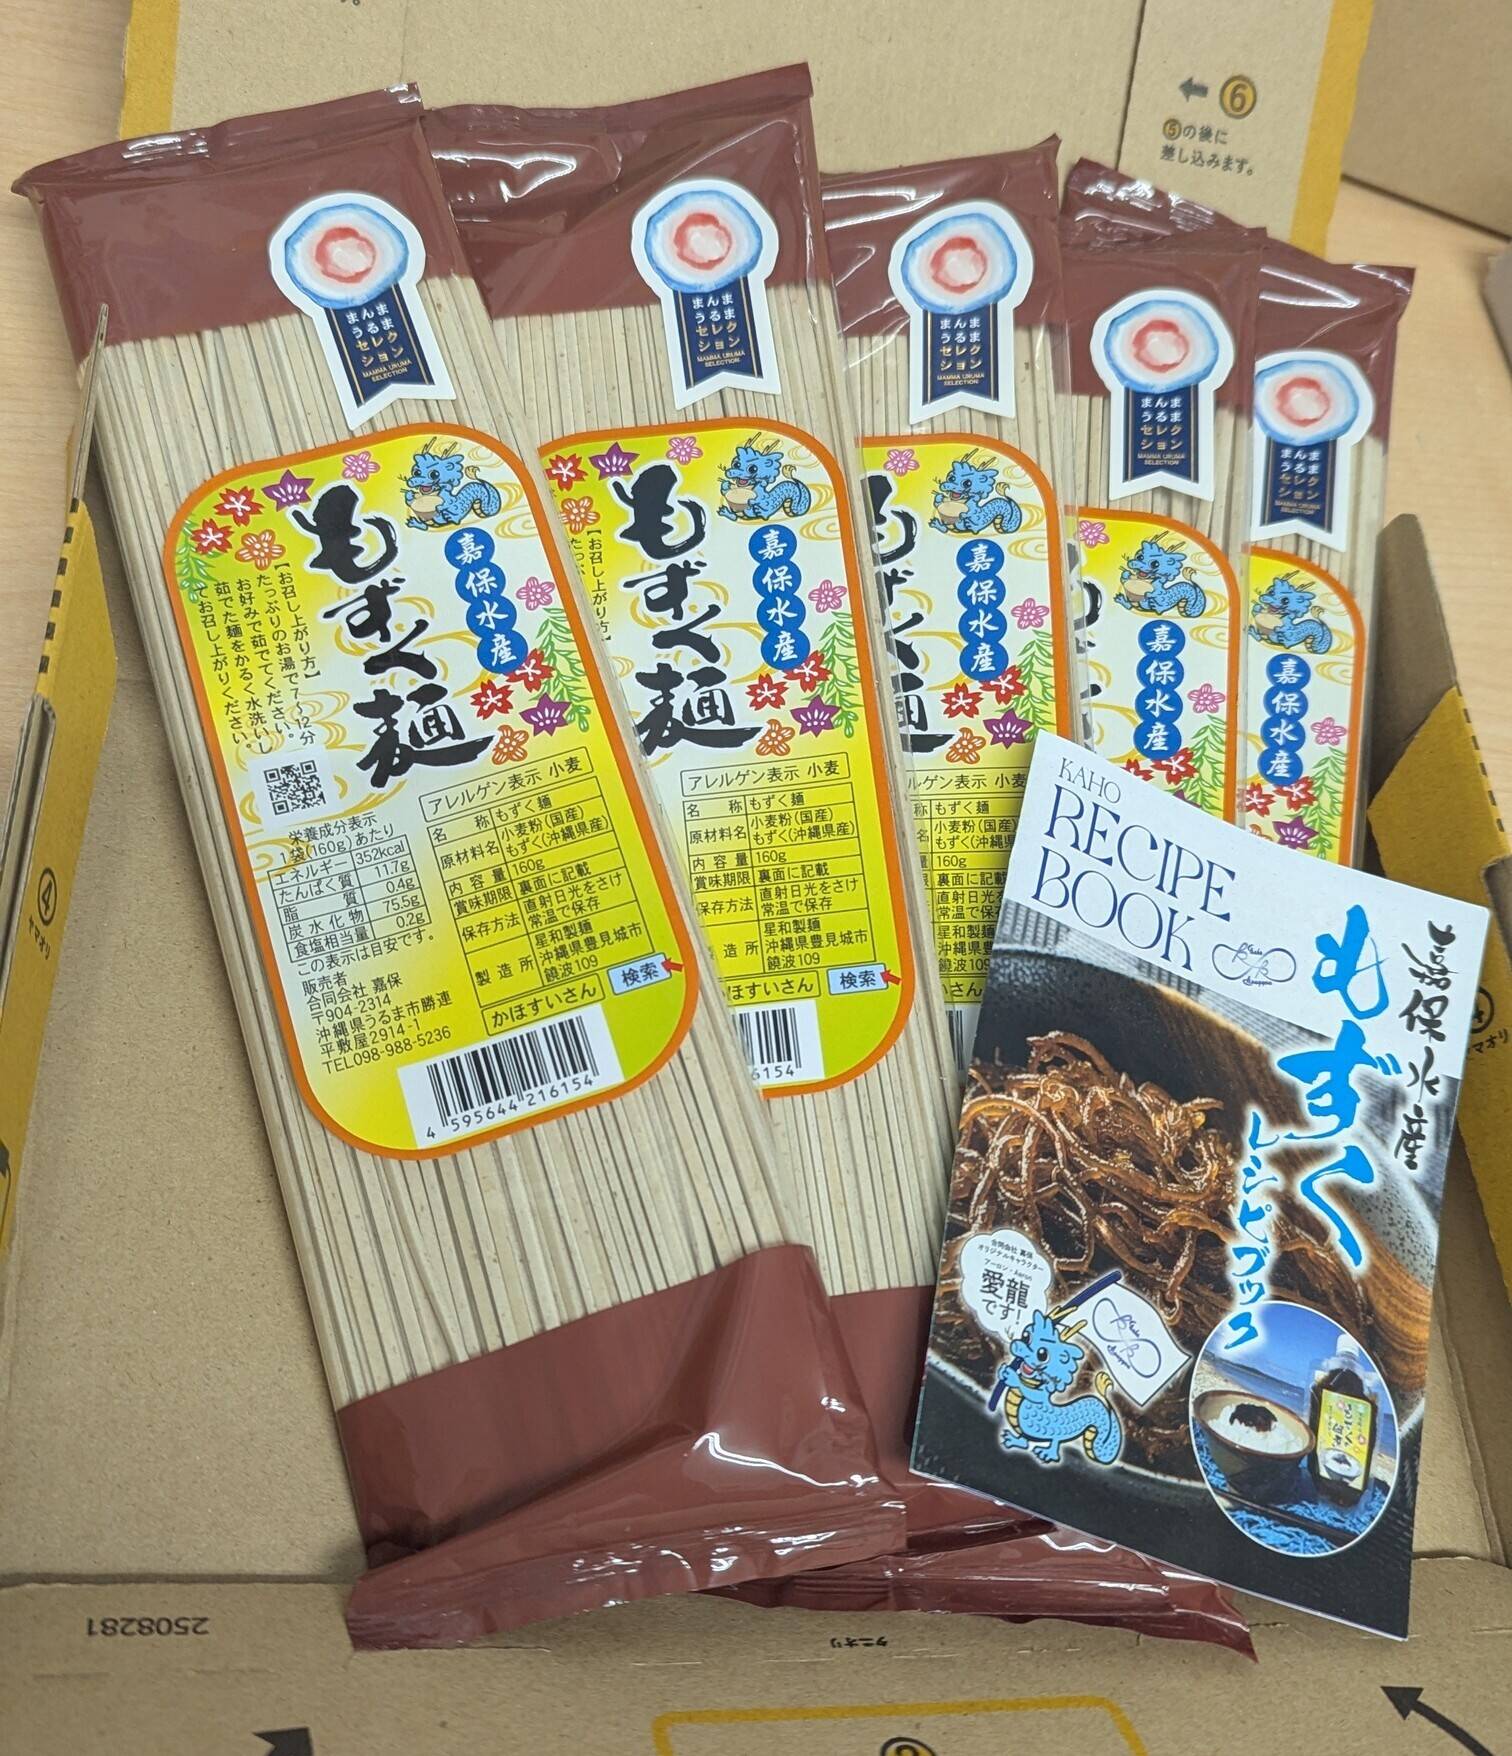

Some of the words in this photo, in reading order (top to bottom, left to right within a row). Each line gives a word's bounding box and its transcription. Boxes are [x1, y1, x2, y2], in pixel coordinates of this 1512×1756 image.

[1160, 144, 1254, 177] 差し込みます。
[346, 303, 390, 325] まんま
[692, 292, 734, 310] まんま
[695, 307, 736, 325] うるま
[351, 316, 395, 340] うるま
[696, 321, 738, 337] セレク
[940, 318, 981, 330] まんま
[940, 332, 981, 344] うるま
[356, 329, 399, 352] セレク
[698, 336, 740, 352] ション
[940, 345, 981, 357] セレク
[361, 346, 404, 368] ション
[704, 358, 741, 368] SELECTION
[940, 359, 983, 371] ション
[371, 366, 408, 383] SELECTION
[1140, 397, 1182, 409] まんま
[1141, 411, 1182, 423] うるま
[1140, 424, 1182, 436] セレク
[1140, 439, 1183, 451] ション
[455, 530, 518, 668] 嘉保水産
[612, 464, 765, 757] もずく麺
[757, 528, 800, 663] 嘉保水産
[964, 543, 1000, 673] 嘉保水産
[274, 562, 321, 680] 【お召し上がり方】
[292, 485, 495, 788] もずく麺
[236, 578, 294, 740] お好みで茹でてください。
[1144, 625, 1177, 752] 嘉保水産
[1265, 658, 1303, 778] 嘉保水産
[429, 770, 543, 816] アレルゲン表示
[549, 755, 583, 779] 小麦
[688, 766, 800, 792] アレルゲン表示
[807, 760, 841, 779] 小麦
[1058, 757, 1122, 804] KAHO
[496, 795, 553, 823] もずく麺
[750, 791, 806, 811] もずく麺
[935, 800, 990, 815] もずく麺
[288, 811, 378, 845] 栄養成分表示
[689, 824, 747, 844] 原材料名
[275, 860, 348, 886] エネルギー
[355, 843, 406, 865] 352kcal
[440, 839, 500, 870] 原材料名
[512, 859, 546, 876] 160g
[756, 849, 788, 864] 160g
[936, 854, 967, 868] 160g
[1043, 784, 1237, 923] RECIPE
[279, 873, 355, 905] たんぱく質
[376, 859, 411, 879] 11.7g
[385, 878, 416, 894] 0.4g
[453, 886, 514, 916] 賞味期限
[519, 861, 593, 895] 裏面に記載
[694, 870, 751, 890] 賞味期限
[757, 861, 830, 883] 裏面に記載
[759, 877, 860, 901] 直射日光をさけ
[382, 893, 422, 913] 75.5g
[523, 872, 623, 913] 直射日光をさけ
[760, 895, 833, 917] 常温で保存
[462, 912, 522, 942] 保存方法
[528, 895, 601, 929] 常温で保存
[1031, 846, 1195, 972] BOOK
[294, 926, 371, 959] 食塩相当量
[396, 911, 426, 929] 0.2g
[535, 919, 594, 949] 星和製麺
[763, 917, 821, 935] 星和製麺
[765, 928, 869, 953] 沖縄県豊見城市
[297, 928, 436, 976] この表示は目安です。
[539, 922, 644, 967] 沖縄県豊見城市
[302, 971, 349, 997] 販売者
[306, 984, 368, 1012] 合同会社
[371, 972, 403, 994] 嘉保
[491, 981, 597, 1028] かほすいさん
[621, 964, 660, 987] 検索
[722, 977, 815, 1001] ほすいさん
[839, 971, 877, 990] 検索
[311, 993, 393, 1027] 〒904-2314
[316, 991, 454, 1043] 沖縄県うるま市勝連
[322, 1025, 452, 1075] TEL098-988-5236
[1277, 904, 1403, 1267] もずく
[426, 1127, 437, 1140] 4
[451, 1099, 518, 1133] 595644
[525, 1074, 594, 1107] 216154
[1223, 1111, 1280, 1350] レシピブック
[980, 1269, 1031, 1309] 愛龍
[86, 1616, 210, 1637] 2508281
